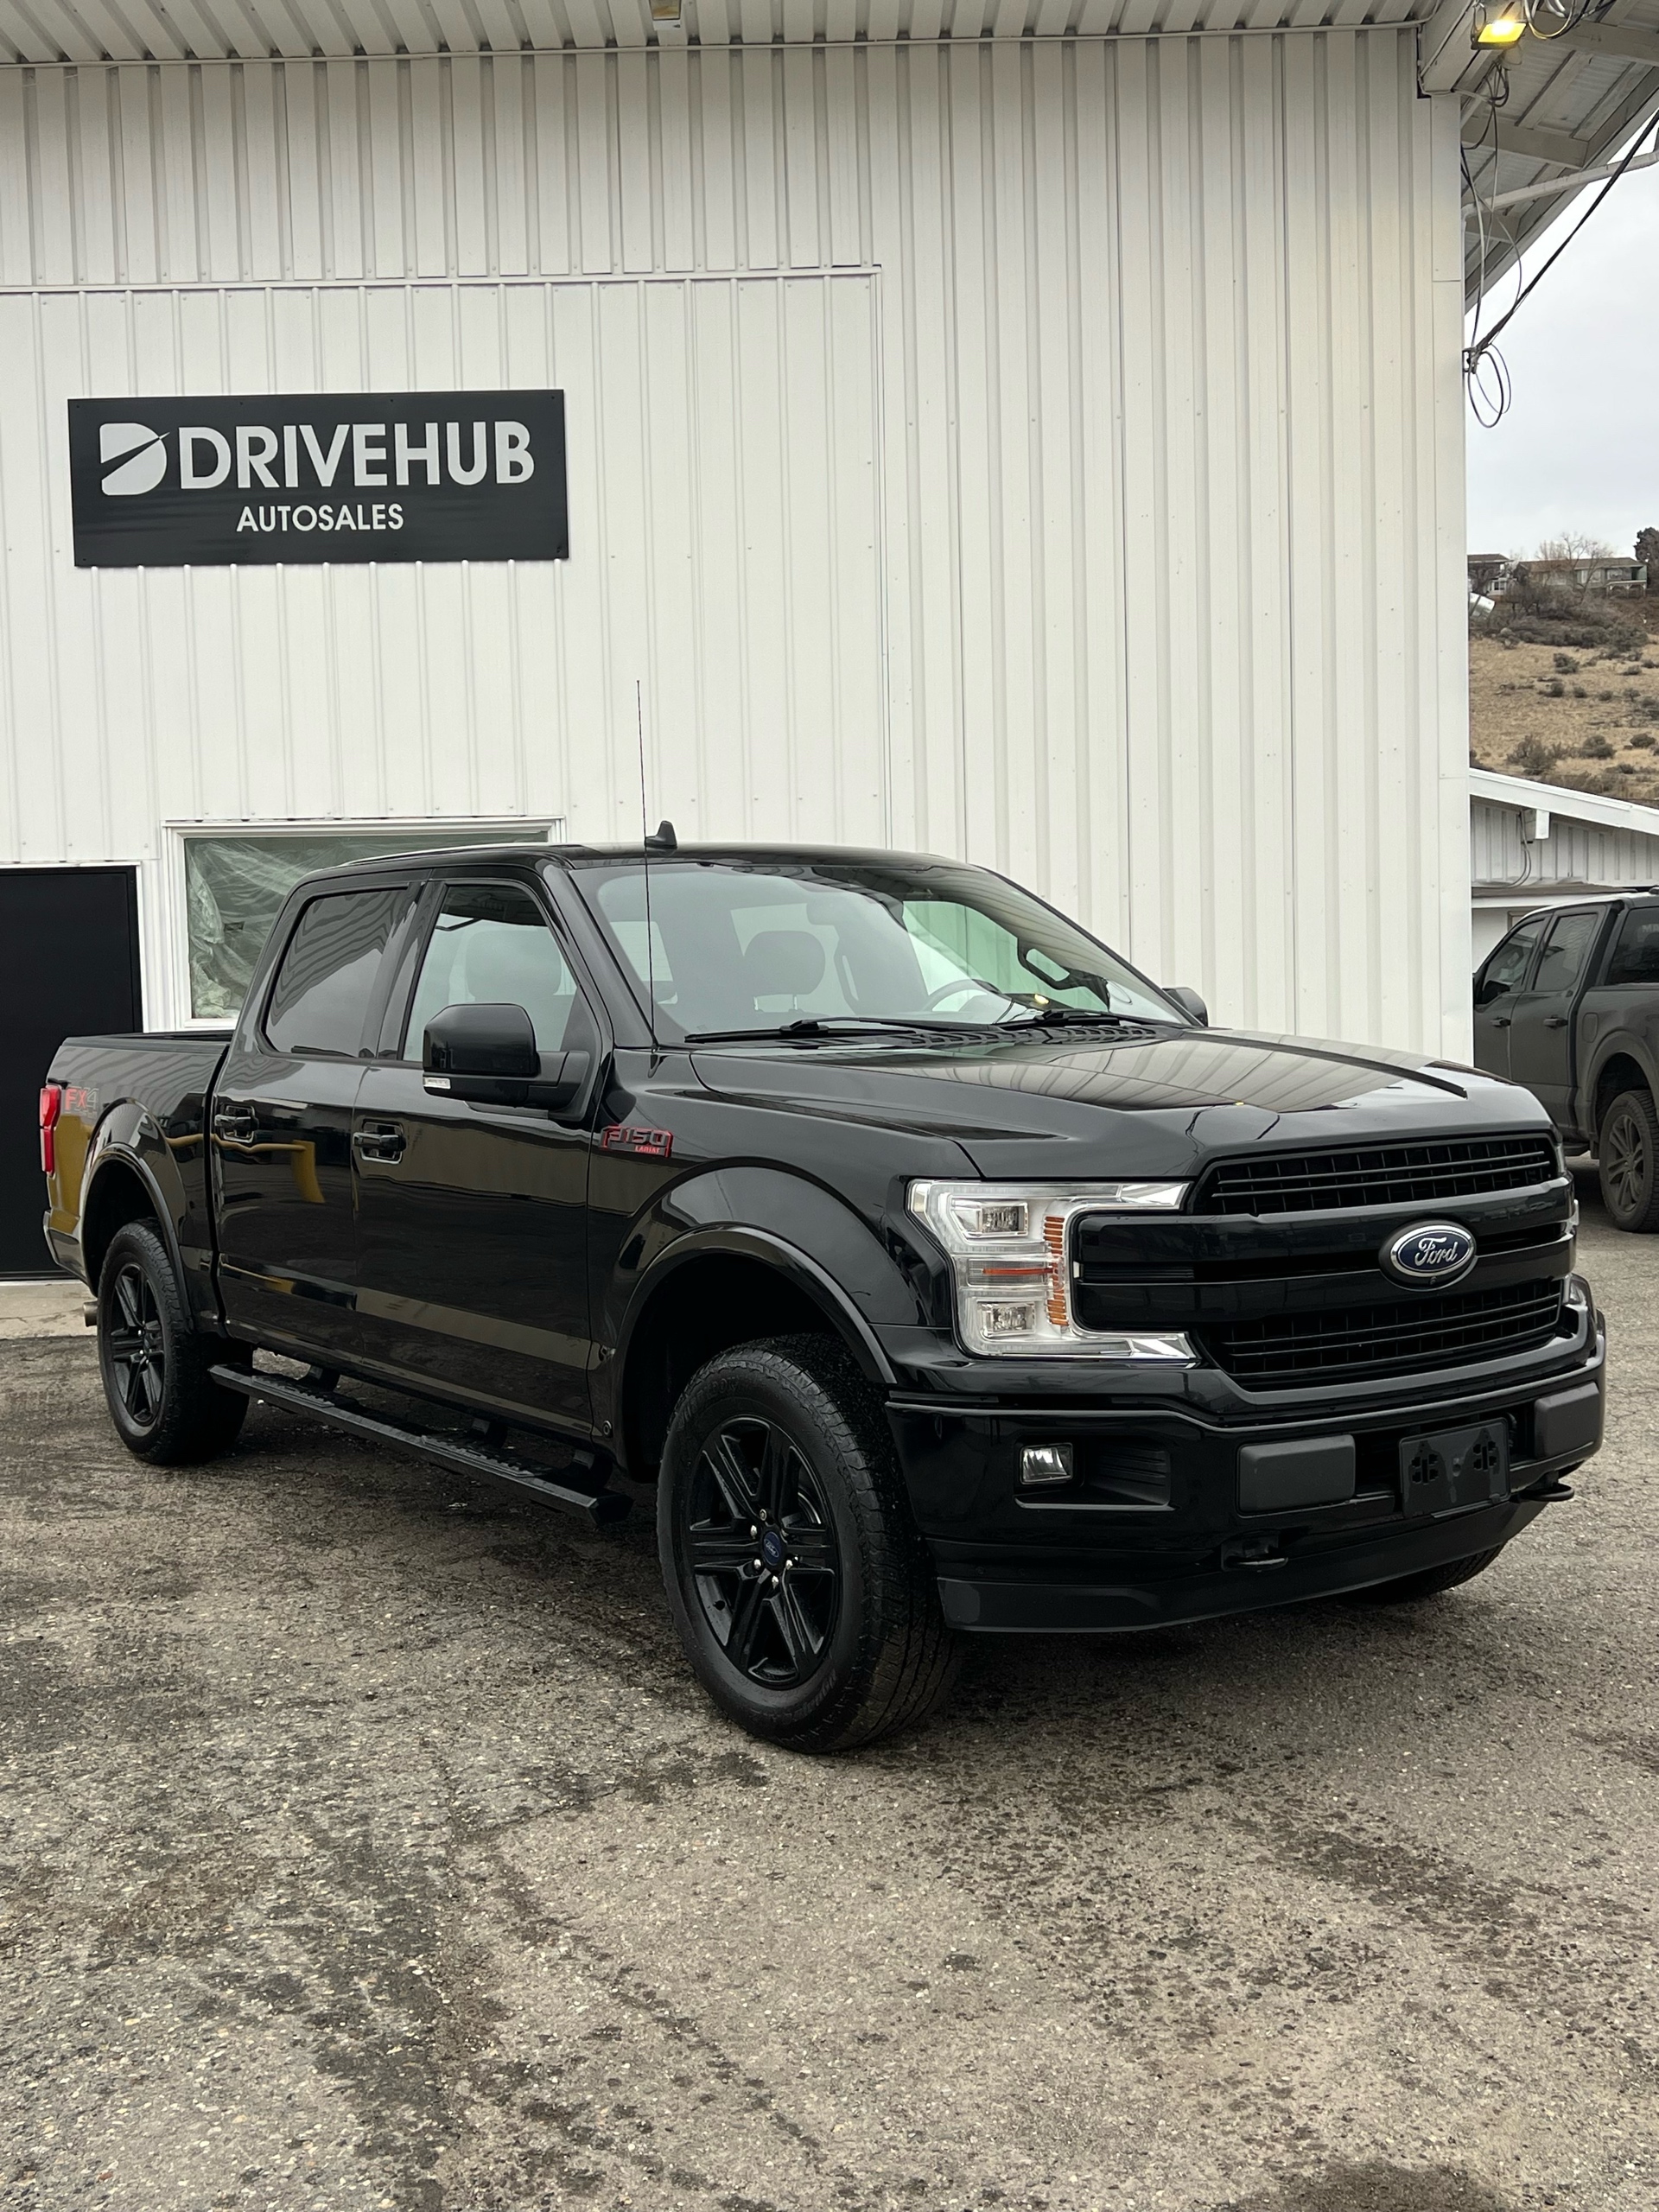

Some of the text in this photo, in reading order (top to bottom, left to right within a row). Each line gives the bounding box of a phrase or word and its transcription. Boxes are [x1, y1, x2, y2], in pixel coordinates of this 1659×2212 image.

[178, 421, 535, 490] DRIVEHUB
[236, 503, 404, 532] AUTOSALES
[65, 1087, 99, 1112] FX4
[634, 1146, 660, 1154] LARIAT
[1414, 1236, 1459, 1267] Ford
